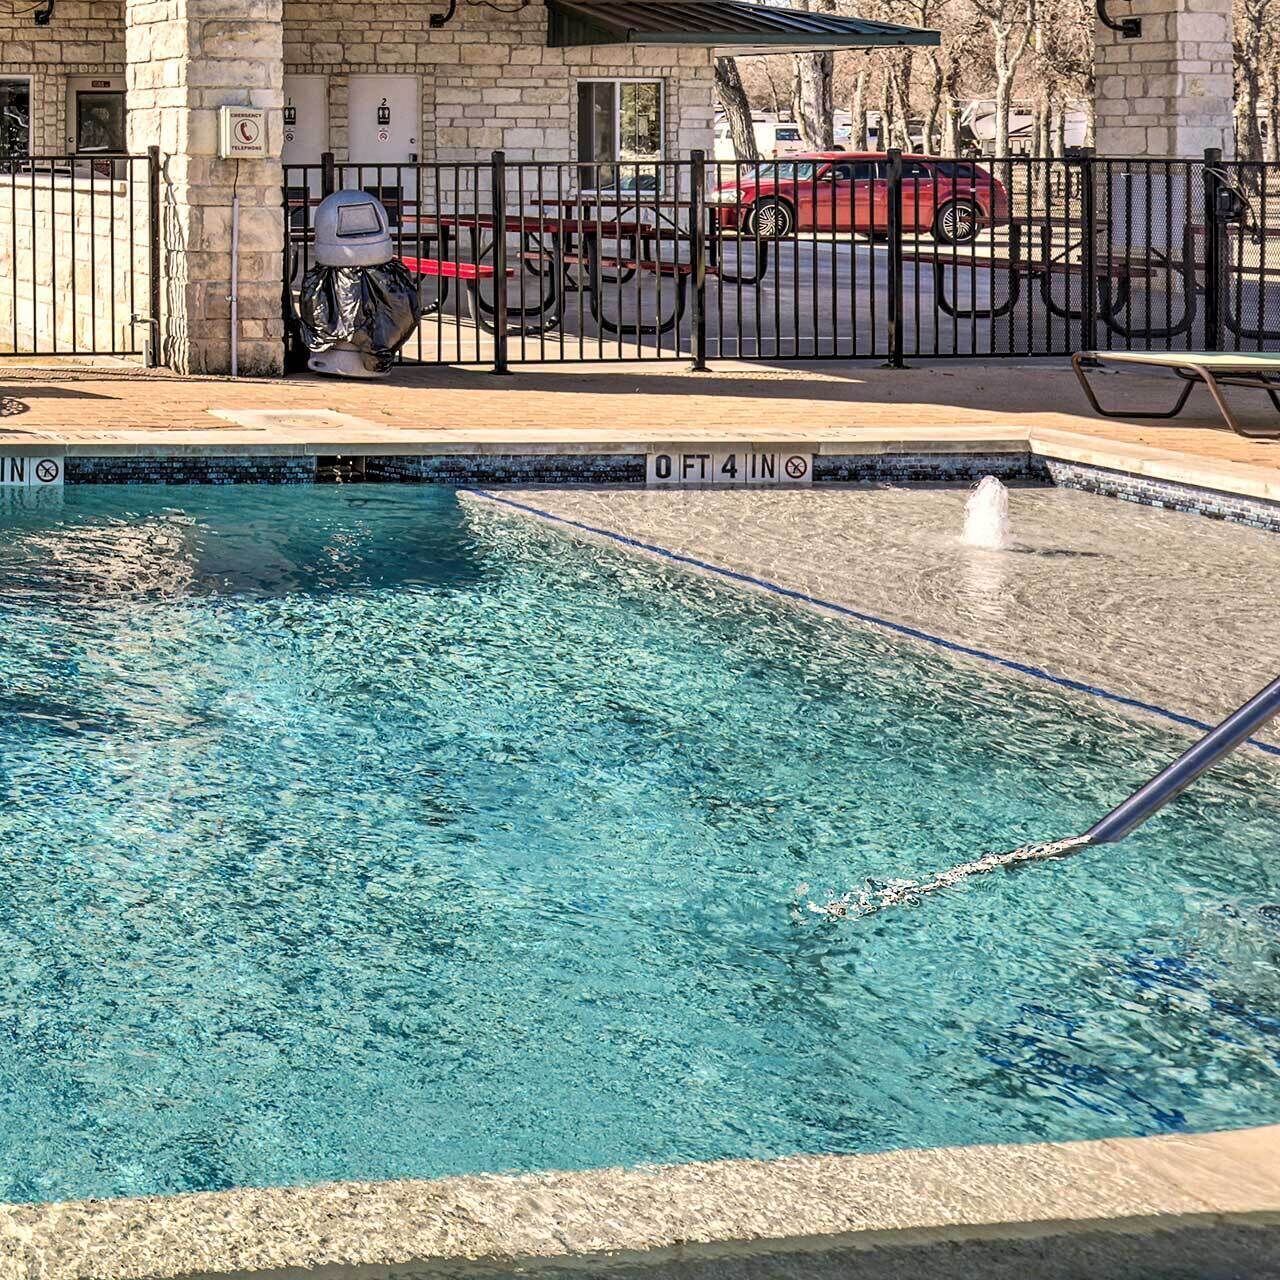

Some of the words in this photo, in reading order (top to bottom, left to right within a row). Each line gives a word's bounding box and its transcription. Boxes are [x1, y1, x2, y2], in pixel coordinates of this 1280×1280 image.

[380, 97, 387, 106] 2
[0, 458, 25, 482] IN
[655, 454, 672, 479] 0
[682, 454, 710, 479] FT
[721, 454, 738, 479] 4
[751, 454, 775, 479] IN
